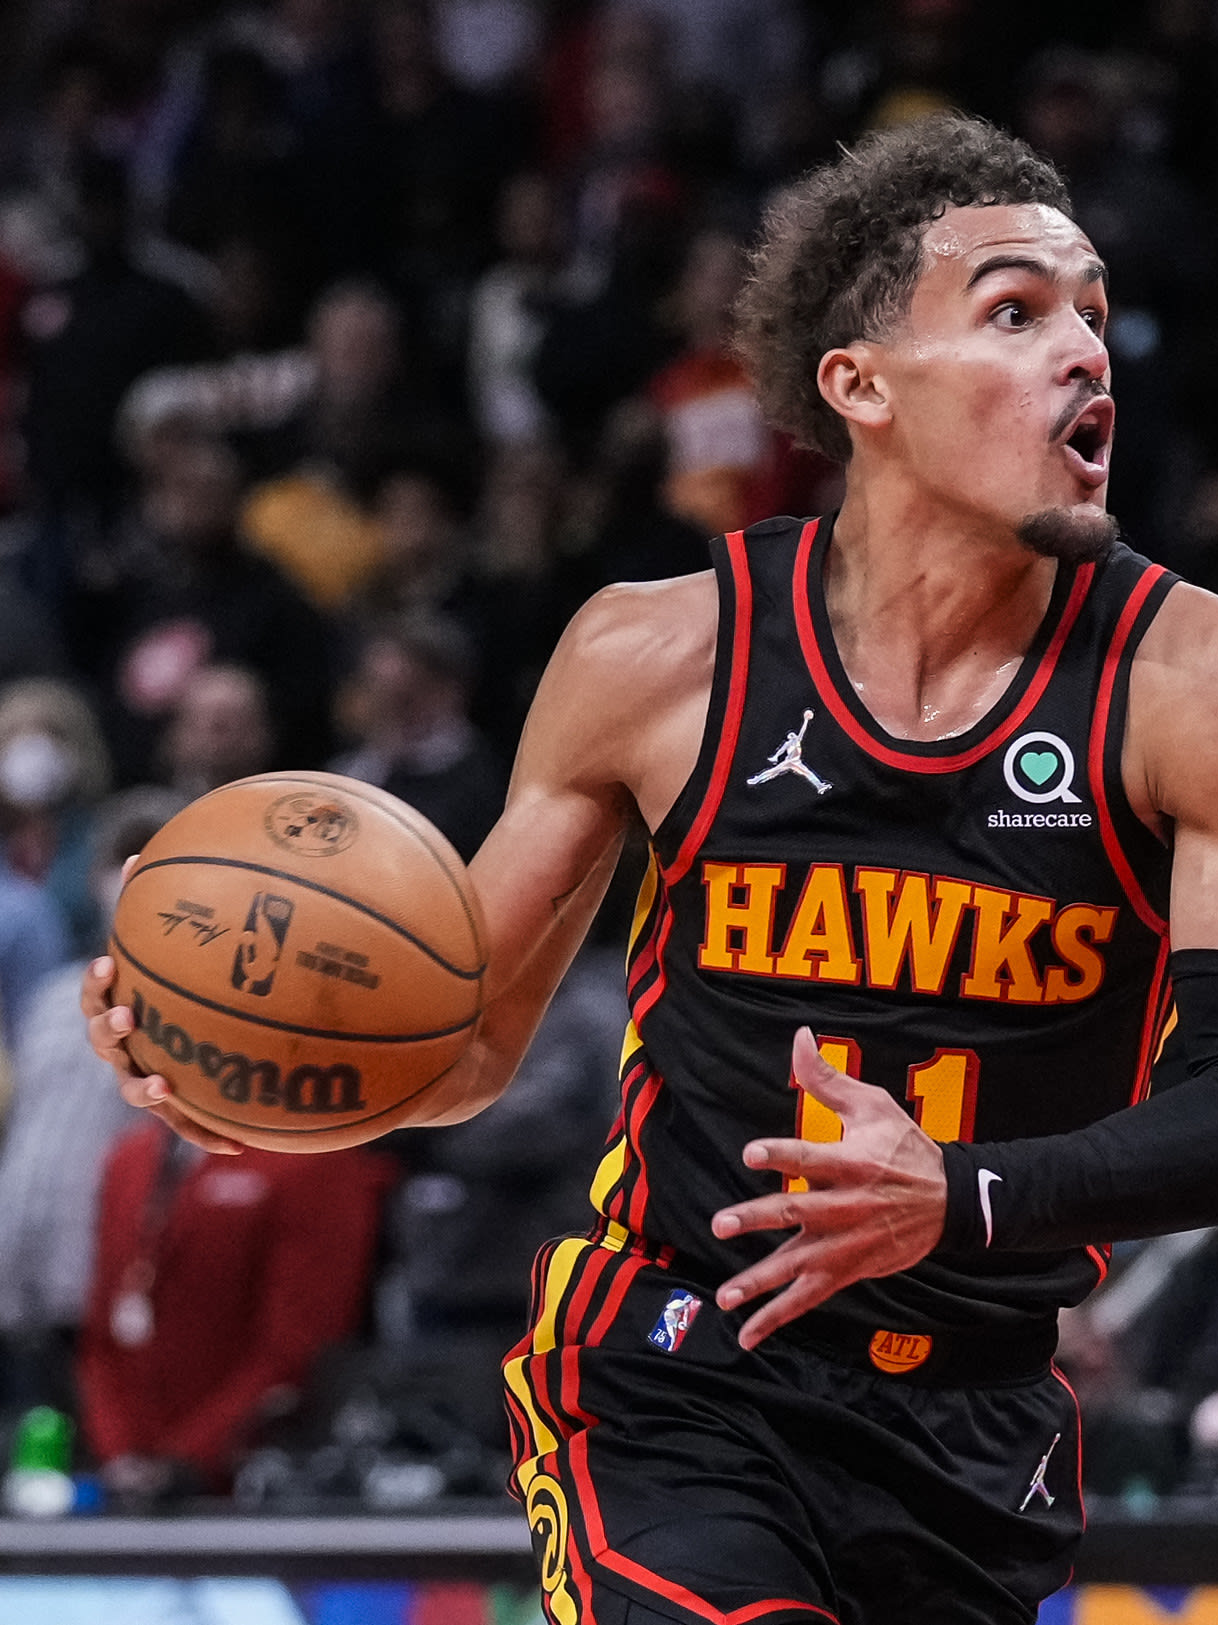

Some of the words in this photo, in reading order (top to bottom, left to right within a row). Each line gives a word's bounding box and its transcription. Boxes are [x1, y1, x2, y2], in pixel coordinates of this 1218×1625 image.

[987, 810, 1092, 828] sharecare
[698, 861, 1119, 1005] HAWKS
[132, 987, 367, 1114] Wilson
[876, 1332, 921, 1360] ATL
